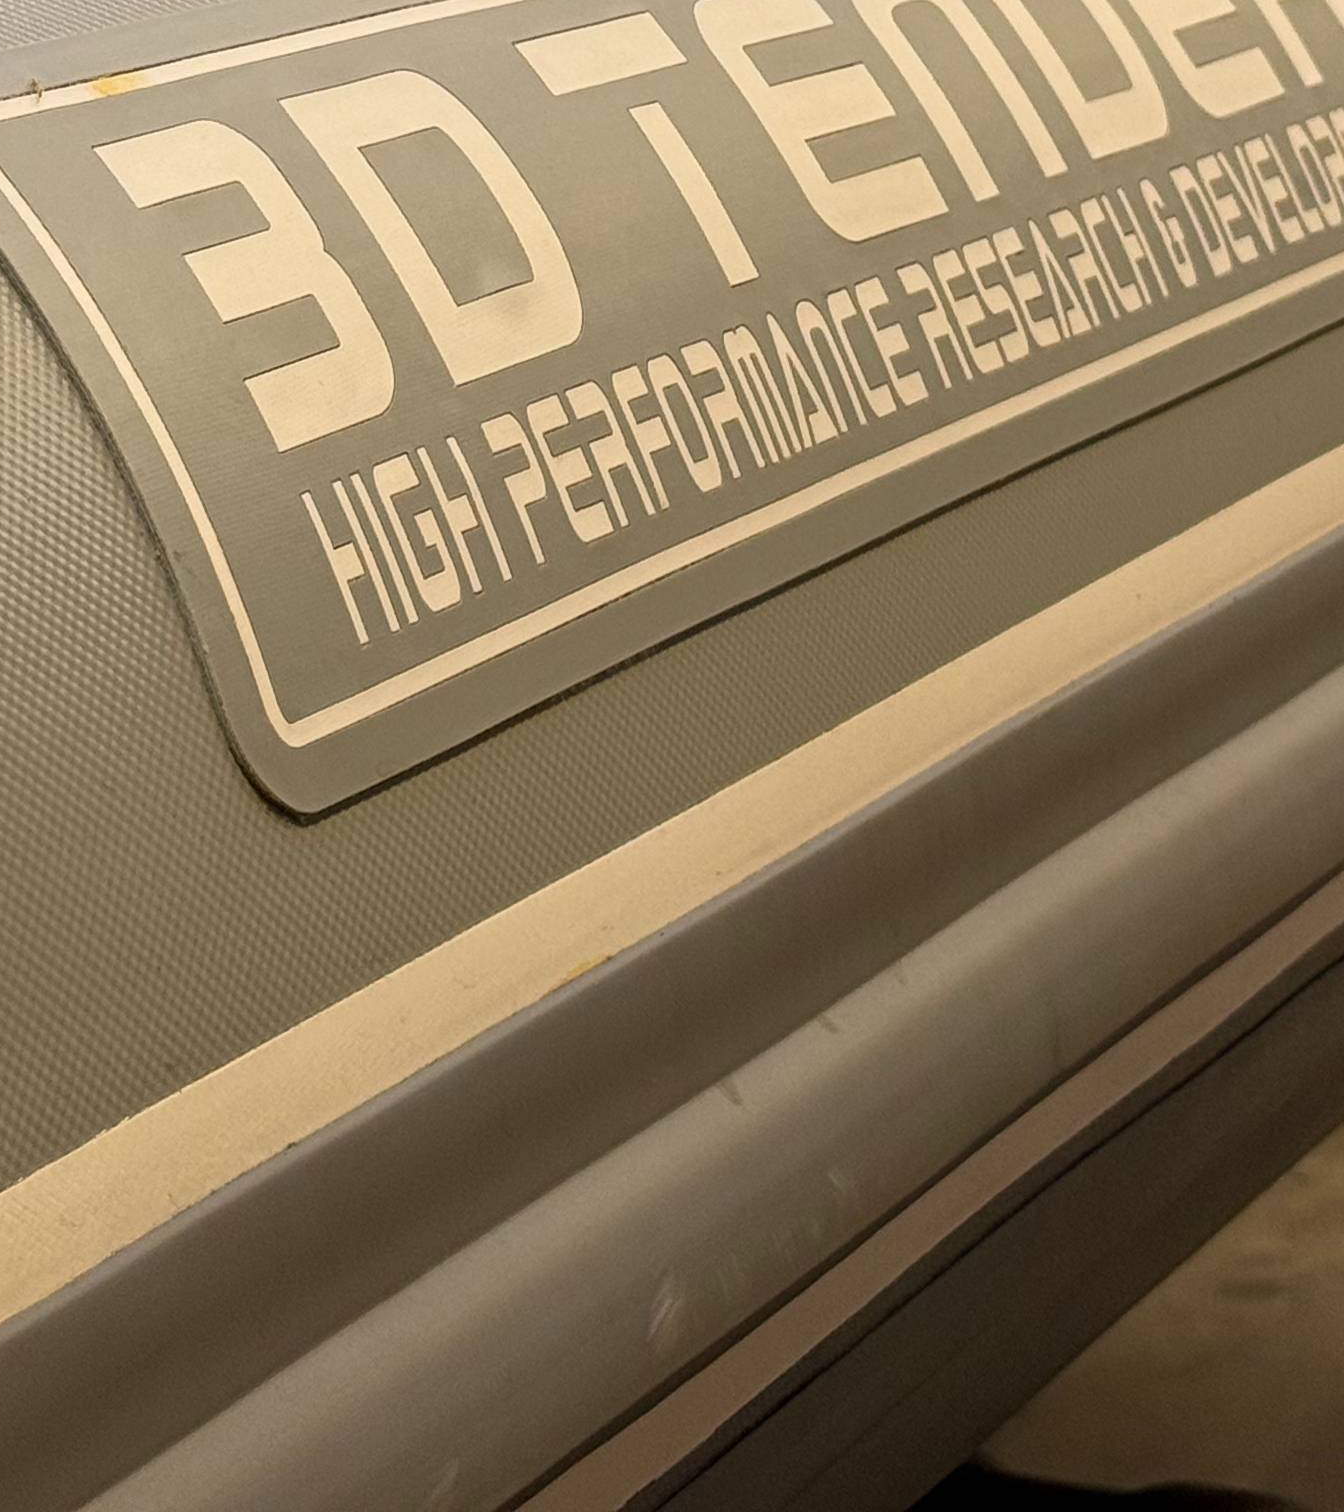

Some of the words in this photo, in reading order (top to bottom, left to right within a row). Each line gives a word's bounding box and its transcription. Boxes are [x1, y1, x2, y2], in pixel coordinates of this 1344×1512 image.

[92, 69, 584, 453] 3D
[300, 436, 513, 645] HIGH
[481, 274, 929, 566] PERFORMANCE
[896, 186, 1169, 390] RESEARCH
[1139, 178, 1197, 287] &
